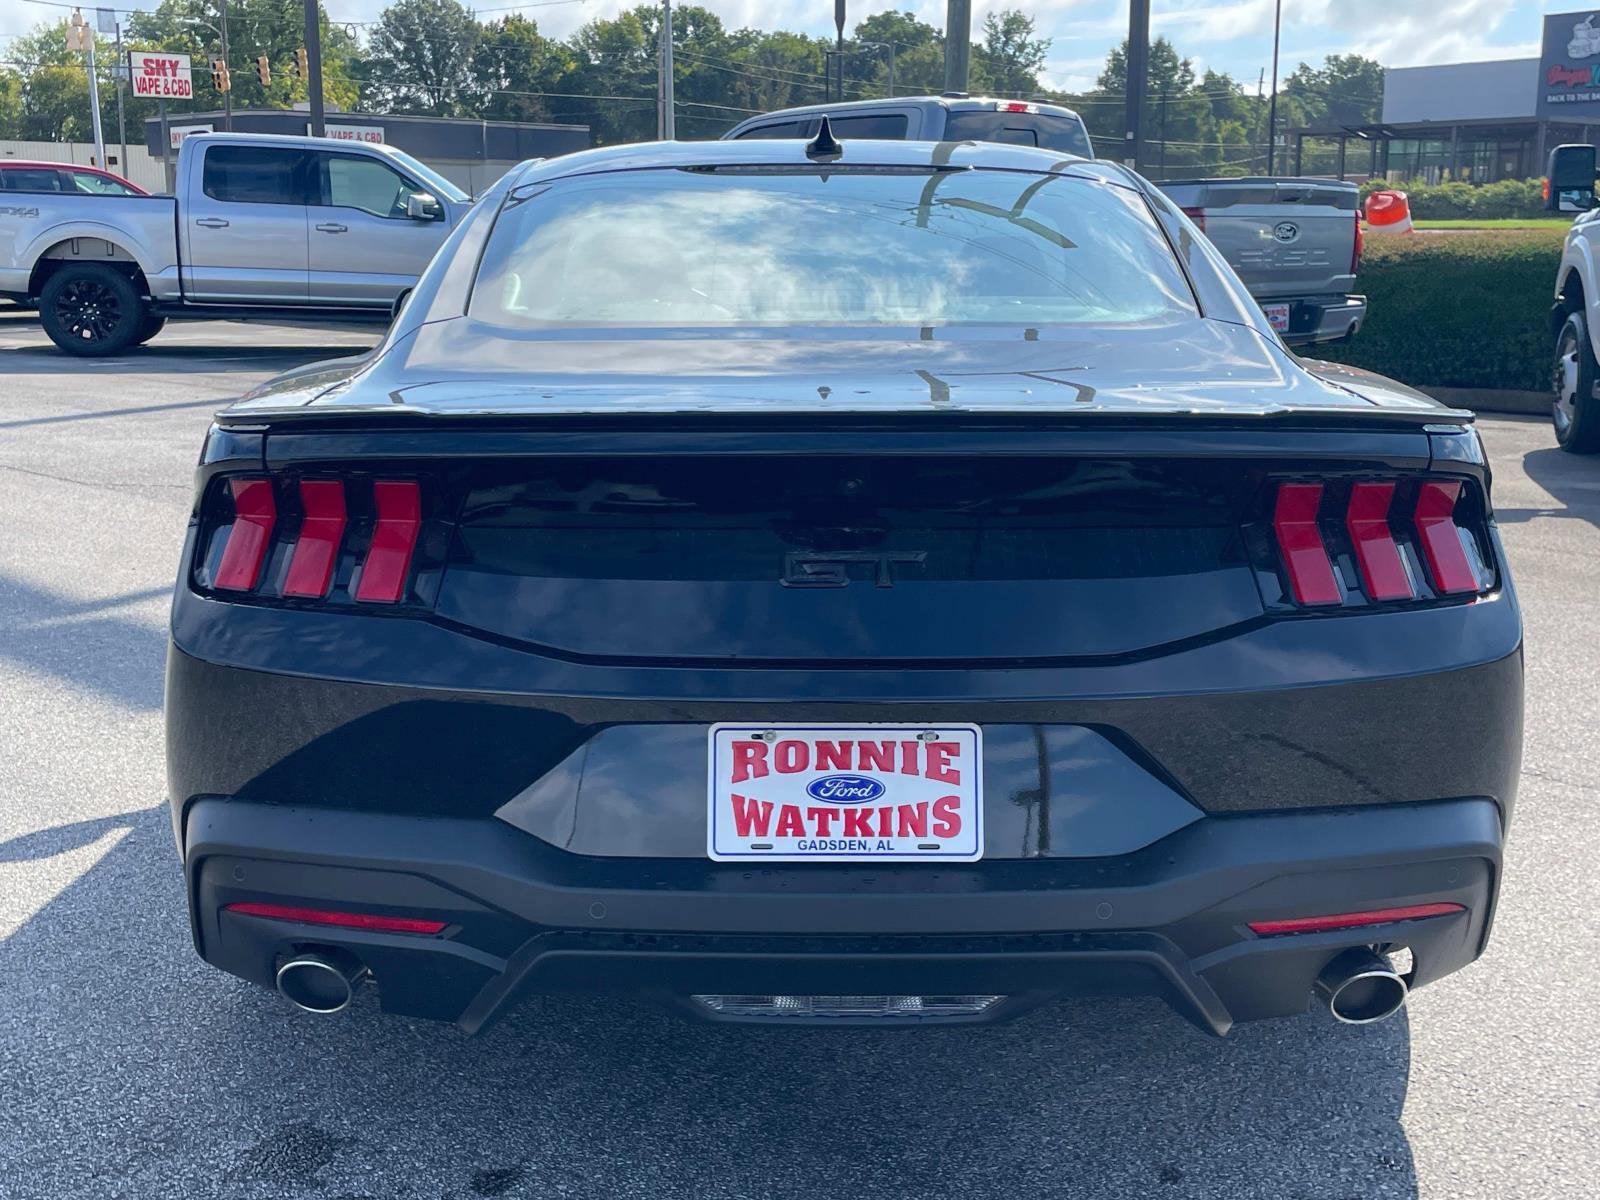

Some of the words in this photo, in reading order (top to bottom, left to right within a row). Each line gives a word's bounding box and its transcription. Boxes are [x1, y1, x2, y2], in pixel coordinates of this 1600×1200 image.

[143, 58, 179, 77] SKY
[135, 76, 161, 95] VAPE
[163, 79, 171, 95] &
[171, 79, 191, 96] CBD
[331, 131, 353, 140] VAPE
[365, 132, 382, 143] CBD
[780, 550, 927, 588] GT
[731, 740, 961, 786] RONNIE
[818, 778, 875, 800] Ford
[731, 793, 962, 838] WATKINS
[797, 839, 871, 852] GADSDEN,
[876, 840, 895, 851] AL
